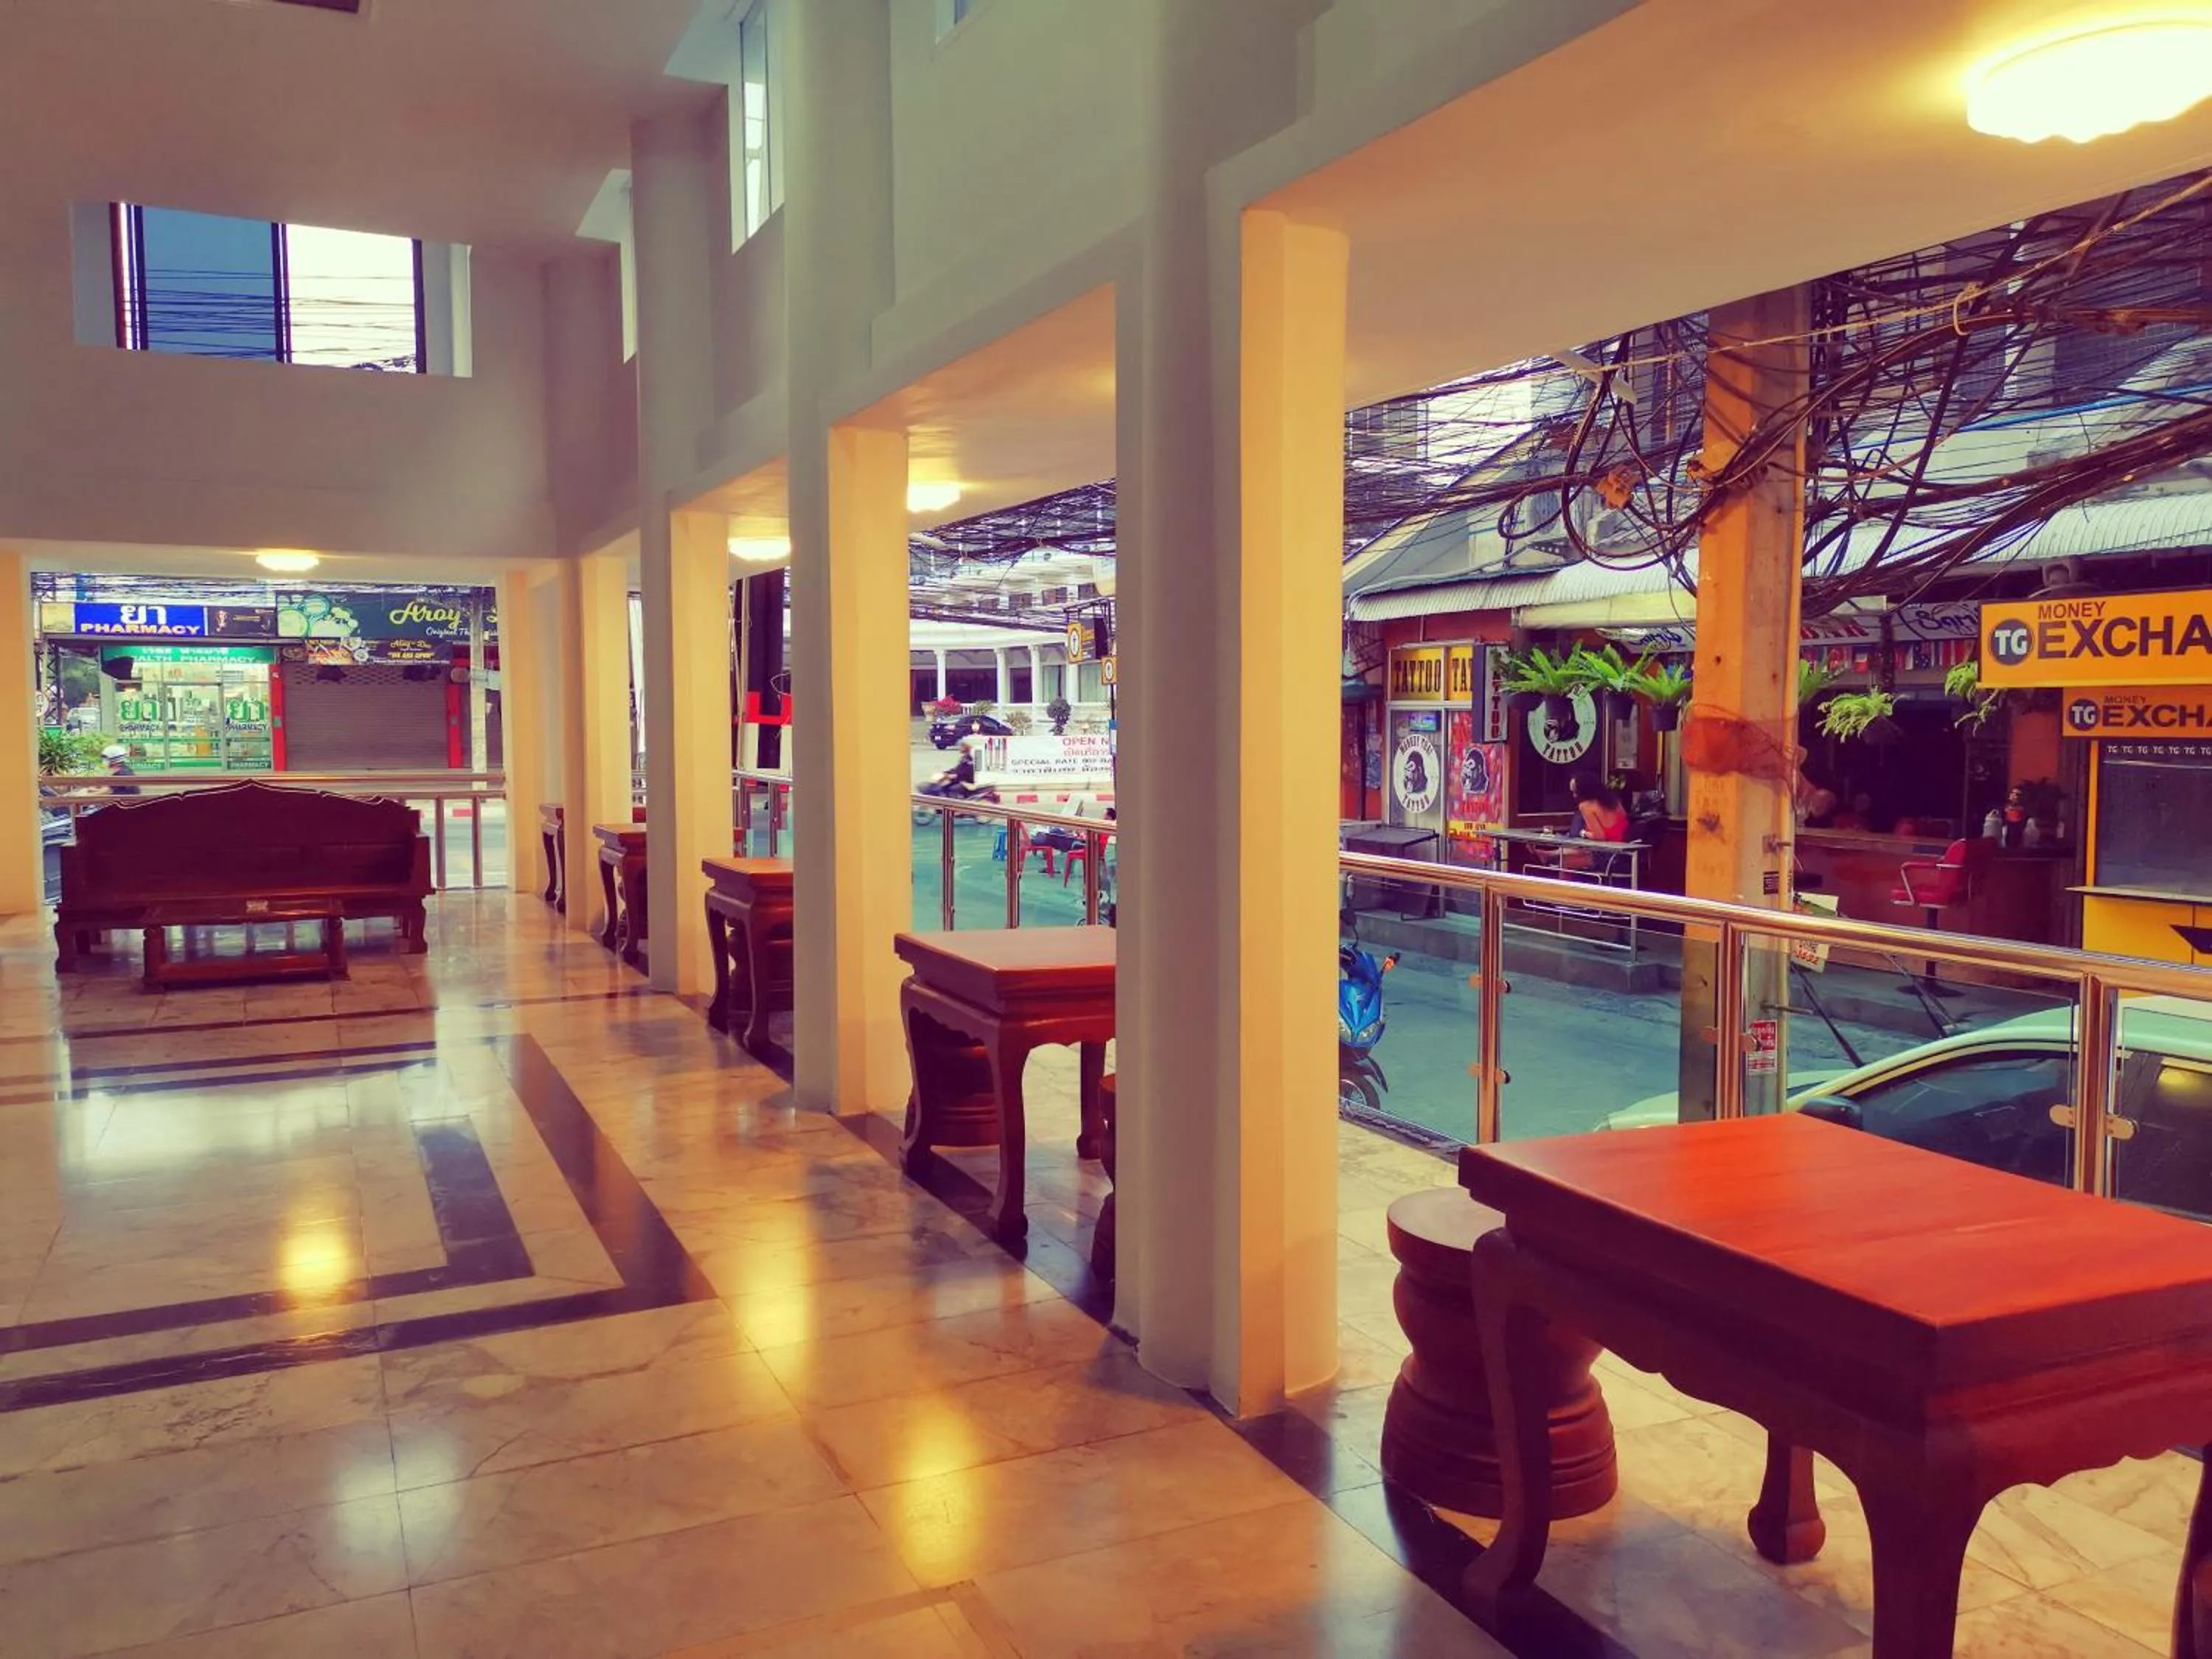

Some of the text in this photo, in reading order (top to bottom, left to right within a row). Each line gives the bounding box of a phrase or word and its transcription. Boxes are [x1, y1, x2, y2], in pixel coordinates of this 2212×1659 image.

[120, 605, 167, 625] ยา
[389, 601, 461, 629] Aroy
[2037, 602, 2106, 619] MONEY
[80, 623, 201, 634] PHARMACY
[1994, 629, 2028, 655] TG
[1394, 658, 1441, 692] TATTOO
[1452, 658, 1472, 692] TA
[2104, 696, 2146, 704] MONEY
[2070, 706, 2096, 724] TG
[1062, 737, 1096, 746] OPEN
[1543, 742, 1583, 762] TATTOO
[1402, 794, 1430, 812] TATTOO
